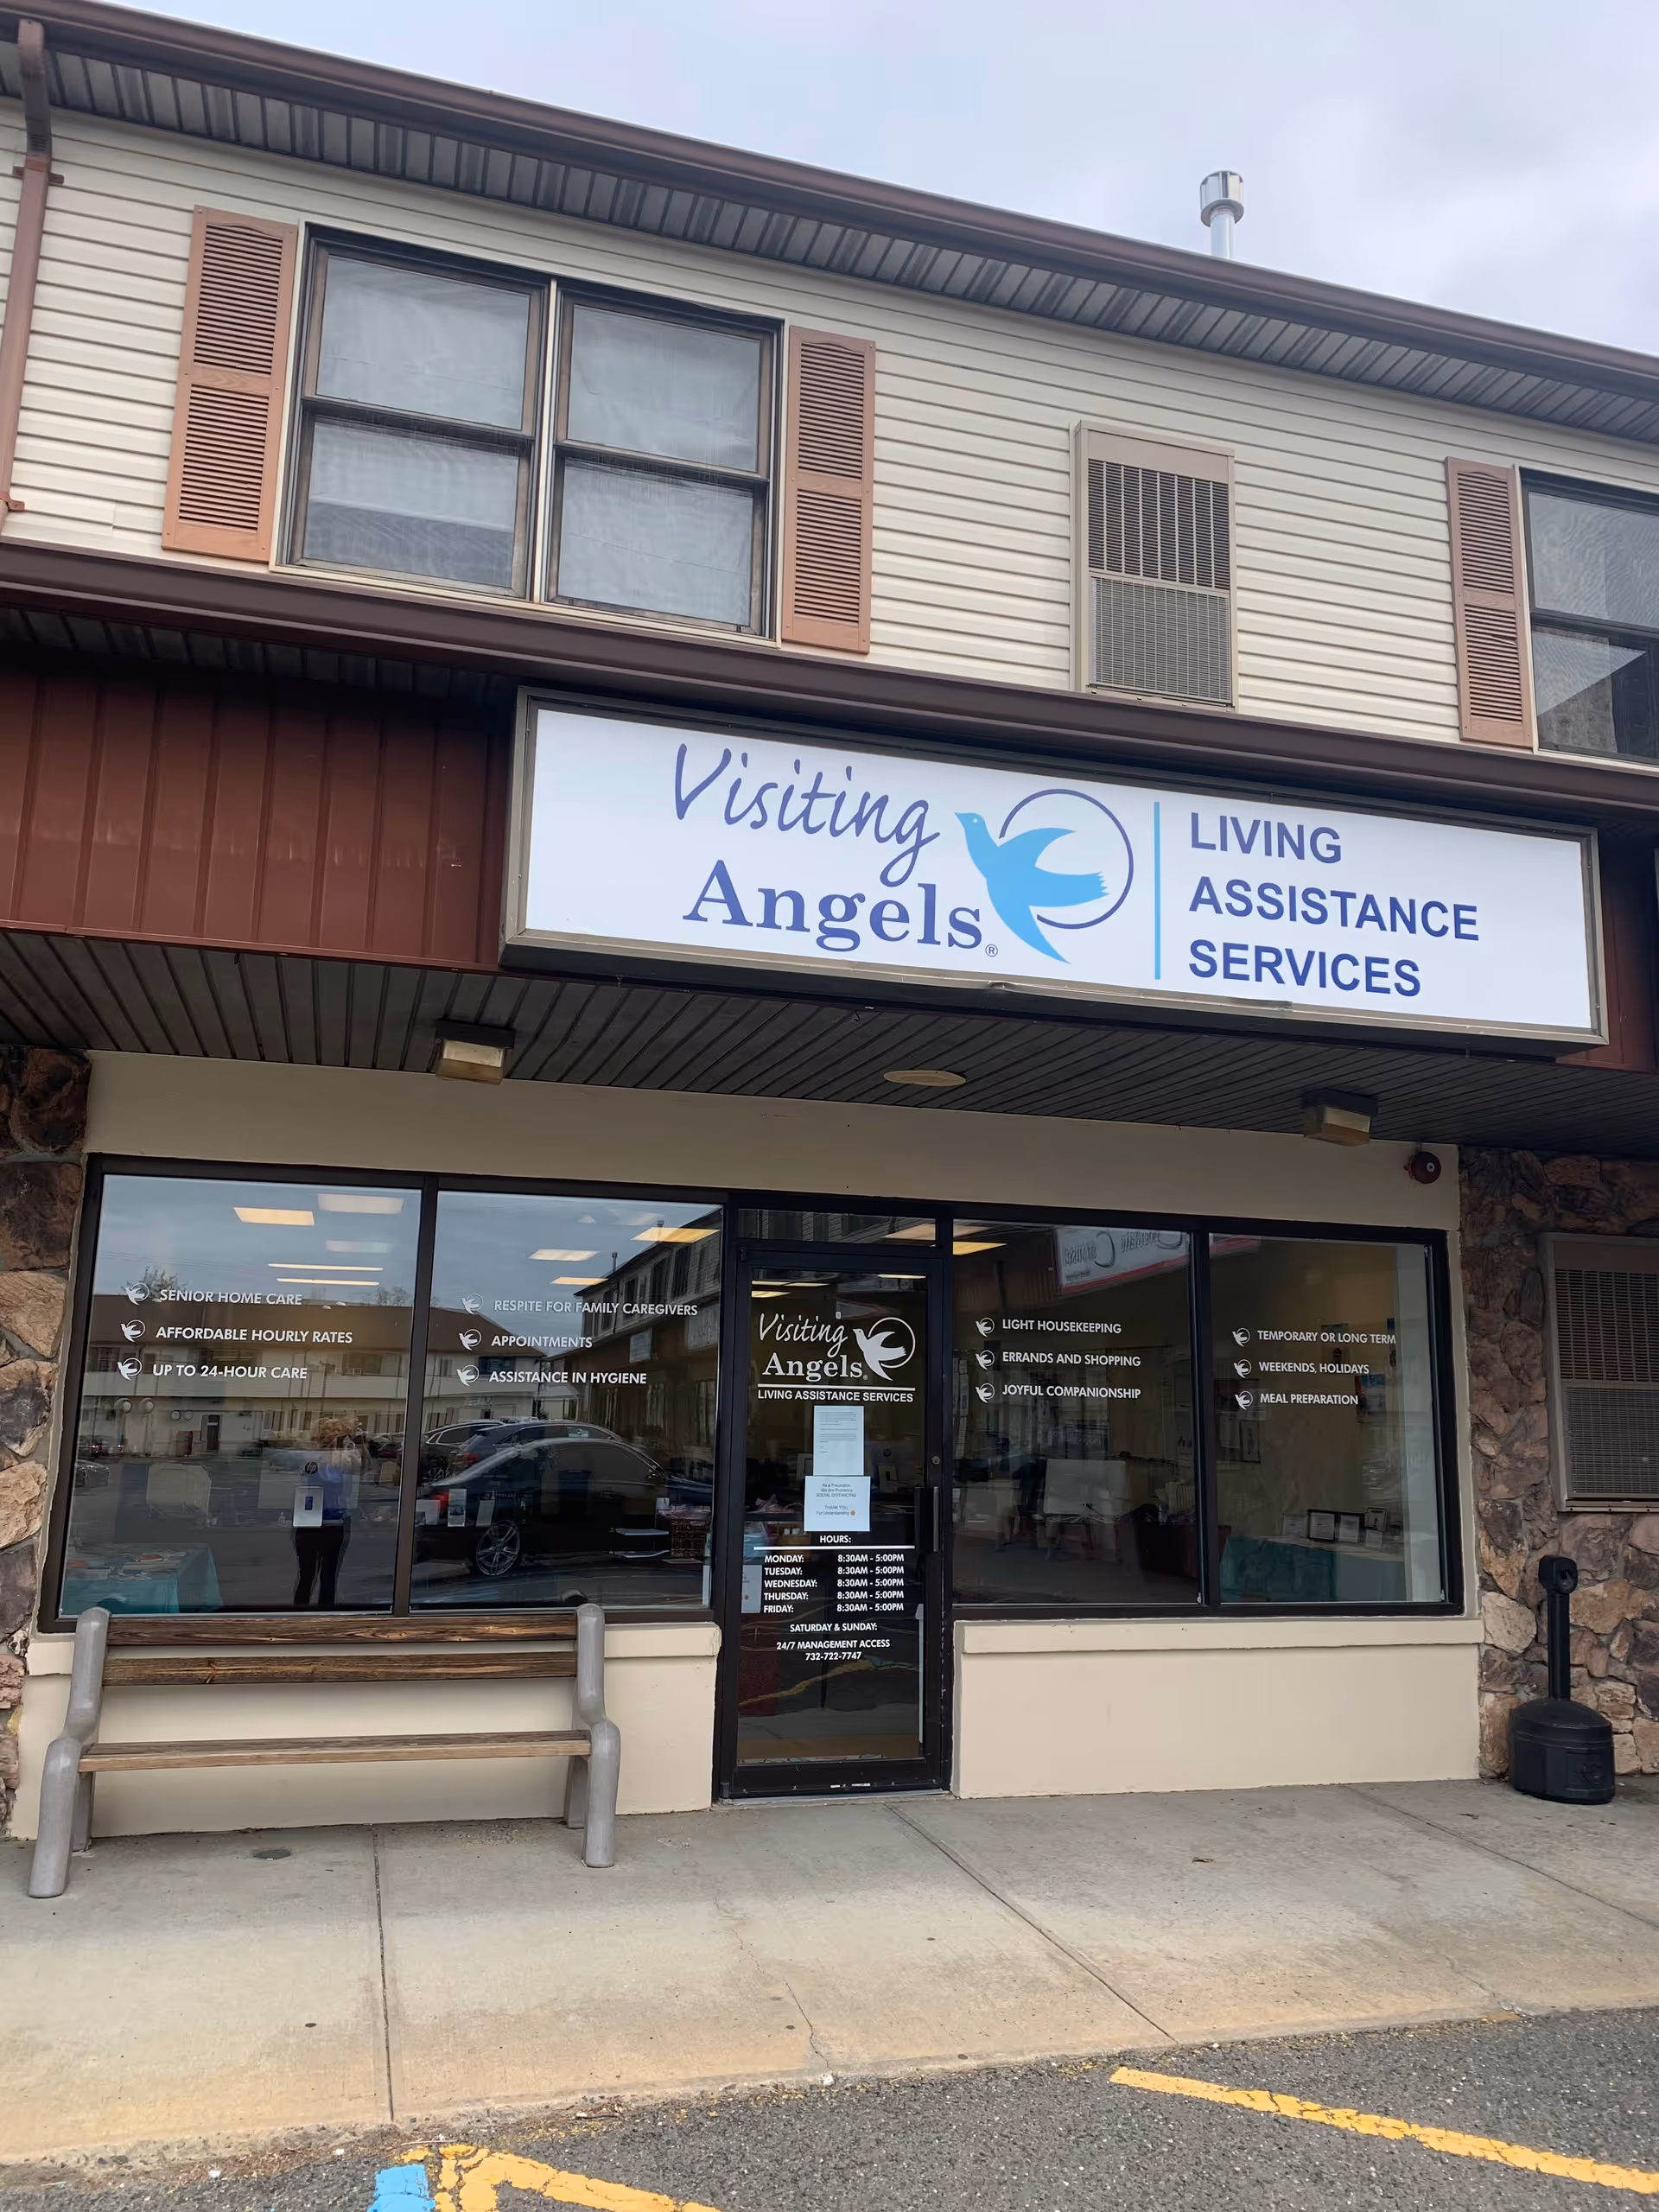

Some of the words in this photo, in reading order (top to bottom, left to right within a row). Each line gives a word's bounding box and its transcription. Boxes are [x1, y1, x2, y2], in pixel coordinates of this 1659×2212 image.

[671, 742, 941, 885] Visiting
[1188, 811, 1343, 865] LIVING
[1187, 877, 1481, 943] ASSISTANCE
[1187, 939, 1422, 998] SERVICES
[159, 1288, 214, 1303] SENIOR
[219, 1291, 262, 1304] HOME
[266, 1293, 302, 1306] CARE
[494, 1300, 542, 1312] RESPITE
[546, 1301, 572, 1313] FOR
[576, 1302, 620, 1314] FAMILY
[622, 1303, 698, 1316] CAREGIVERS
[1002, 1319, 1034, 1331] LIGHT
[1038, 1320, 1122, 1334] HOUSEKEEPING
[156, 1326, 247, 1340] AFFORDABLE
[251, 1330, 309, 1343] HOURLY
[312, 1332, 353, 1344] RATES
[491, 1336, 593, 1348] APPOINTMENTS
[759, 1313, 849, 1358] Visiting
[1257, 1331, 1318, 1342] TEMPORARY
[1320, 1332, 1336, 1343] OR
[1338, 1332, 1367, 1344] LONG
[1370, 1334, 1396, 1344] TERM
[1002, 1352, 1053, 1363] ERRANDS
[1056, 1353, 1082, 1364] AND
[1084, 1355, 1141, 1367] SHOPPING
[153, 1364, 173, 1376] UP
[176, 1365, 196, 1377] TO
[200, 1365, 267, 1379] 24-HOUR
[271, 1367, 308, 1379] CARE
[1258, 1362, 1317, 1374] WEEKENDS,
[1319, 1363, 1369, 1374] HOLIDAYS
[489, 1370, 568, 1383] ASSISTANCE
[572, 1372, 587, 1383] IN
[590, 1372, 646, 1384] HYGIENE
[758, 1390, 792, 1400] LIVING
[795, 1391, 860, 1401] ASSISTANCE
[862, 1392, 913, 1402] SERVICES
[1002, 1385, 1043, 1396] JOYFUL
[1046, 1386, 1141, 1399] COMPANIONSHIP
[1260, 1394, 1287, 1404] MEAL
[1291, 1395, 1358, 1405] PREPARATION
[764, 1580, 817, 1588] WEDNESDAY:
[837, 1579, 868, 1587] 8:30AM
[874, 1579, 905, 1587] 5:00PM
[764, 1605, 793, 1613] FRIDAY:
[790, 1624, 832, 1632] SATURDAY
[777, 1641, 795, 1650] 24/7
[797, 1640, 857, 1649] MANAGEMENT
[860, 1639, 890, 1648] ACCESS
[805, 1652, 861, 1661] 732-722-7747
